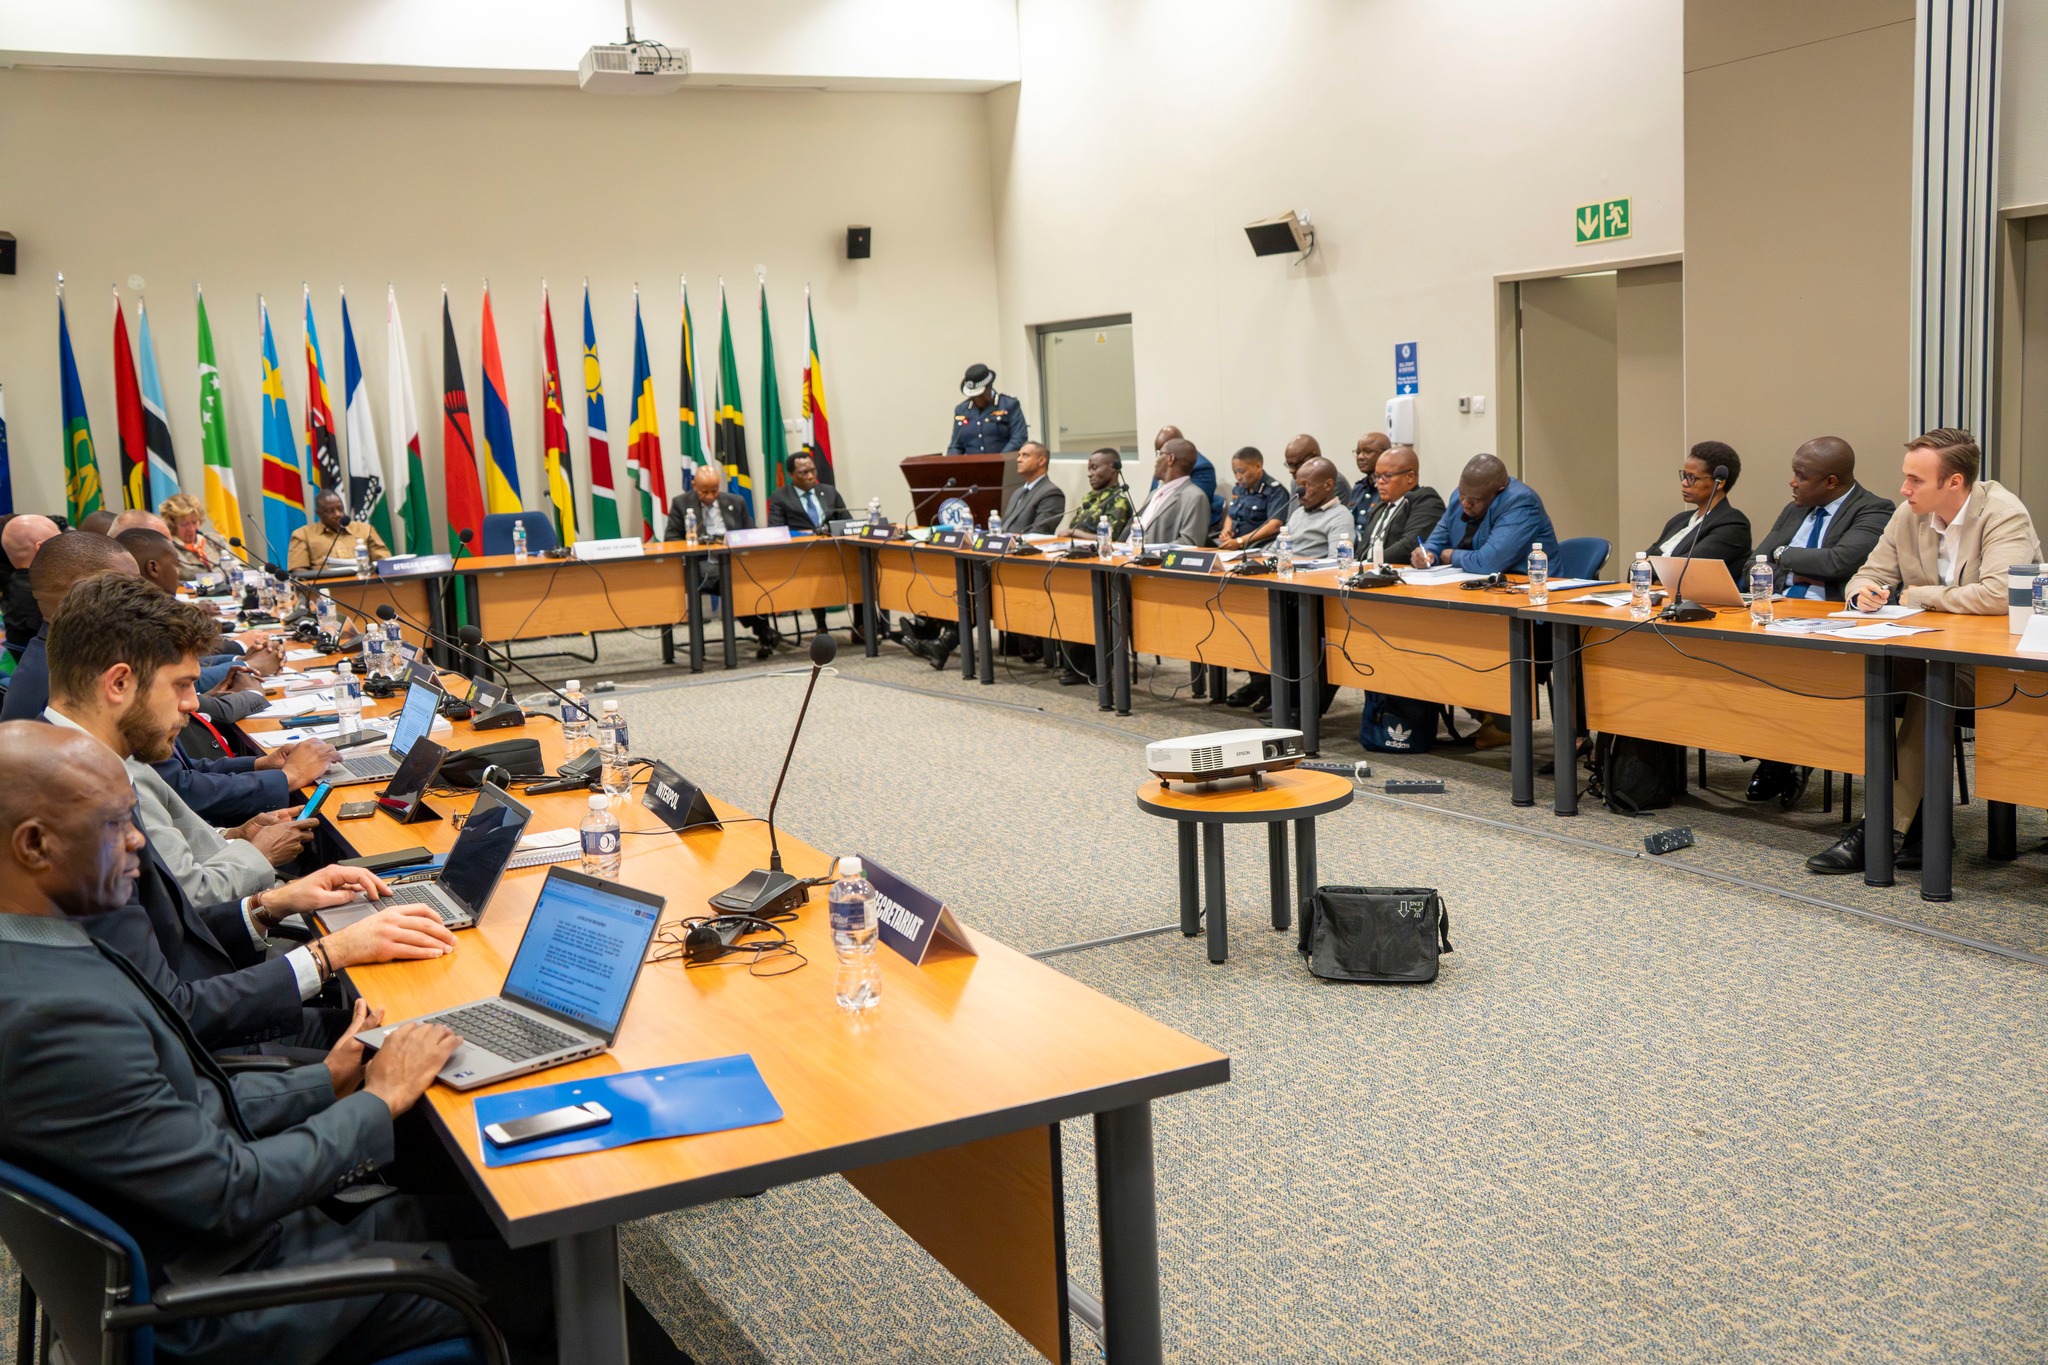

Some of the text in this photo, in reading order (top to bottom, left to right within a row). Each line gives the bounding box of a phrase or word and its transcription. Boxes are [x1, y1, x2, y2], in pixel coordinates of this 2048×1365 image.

[393, 561, 419, 570] AFRICAN
[1385, 740, 1410, 748] adidas
[655, 780, 680, 810] INTERPOL
